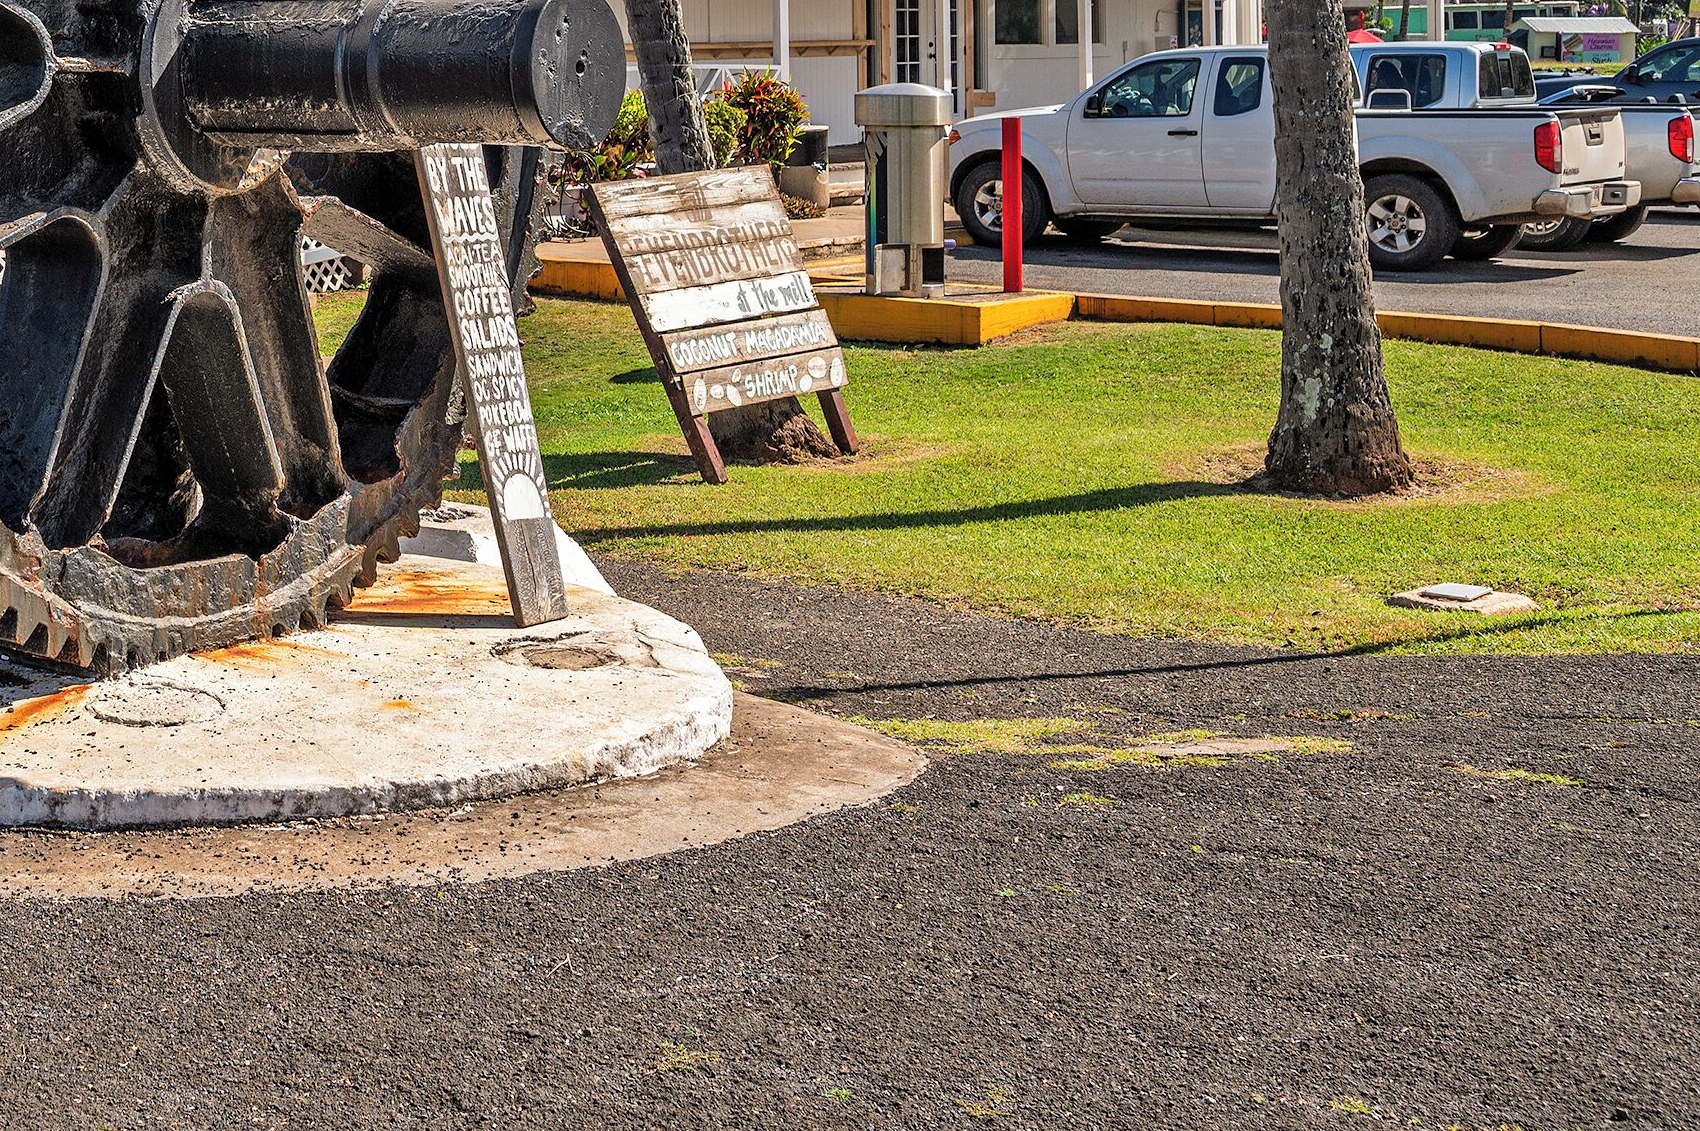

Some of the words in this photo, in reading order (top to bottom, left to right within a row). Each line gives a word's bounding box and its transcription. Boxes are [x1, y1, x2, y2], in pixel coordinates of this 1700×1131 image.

[426, 156, 449, 194] BY
[450, 156, 488, 192] THE
[433, 195, 497, 234] WAVES
[454, 286, 511, 317] COFFEE
[736, 282, 752, 313] at
[751, 280, 779, 311] the
[778, 273, 810, 306] mill
[460, 314, 519, 349] SALADS
[670, 331, 740, 368] COCONUT
[743, 321, 829, 355] MACADAMIA
[467, 350, 524, 379] SANDWICH
[744, 364, 798, 399] SHRIMP
